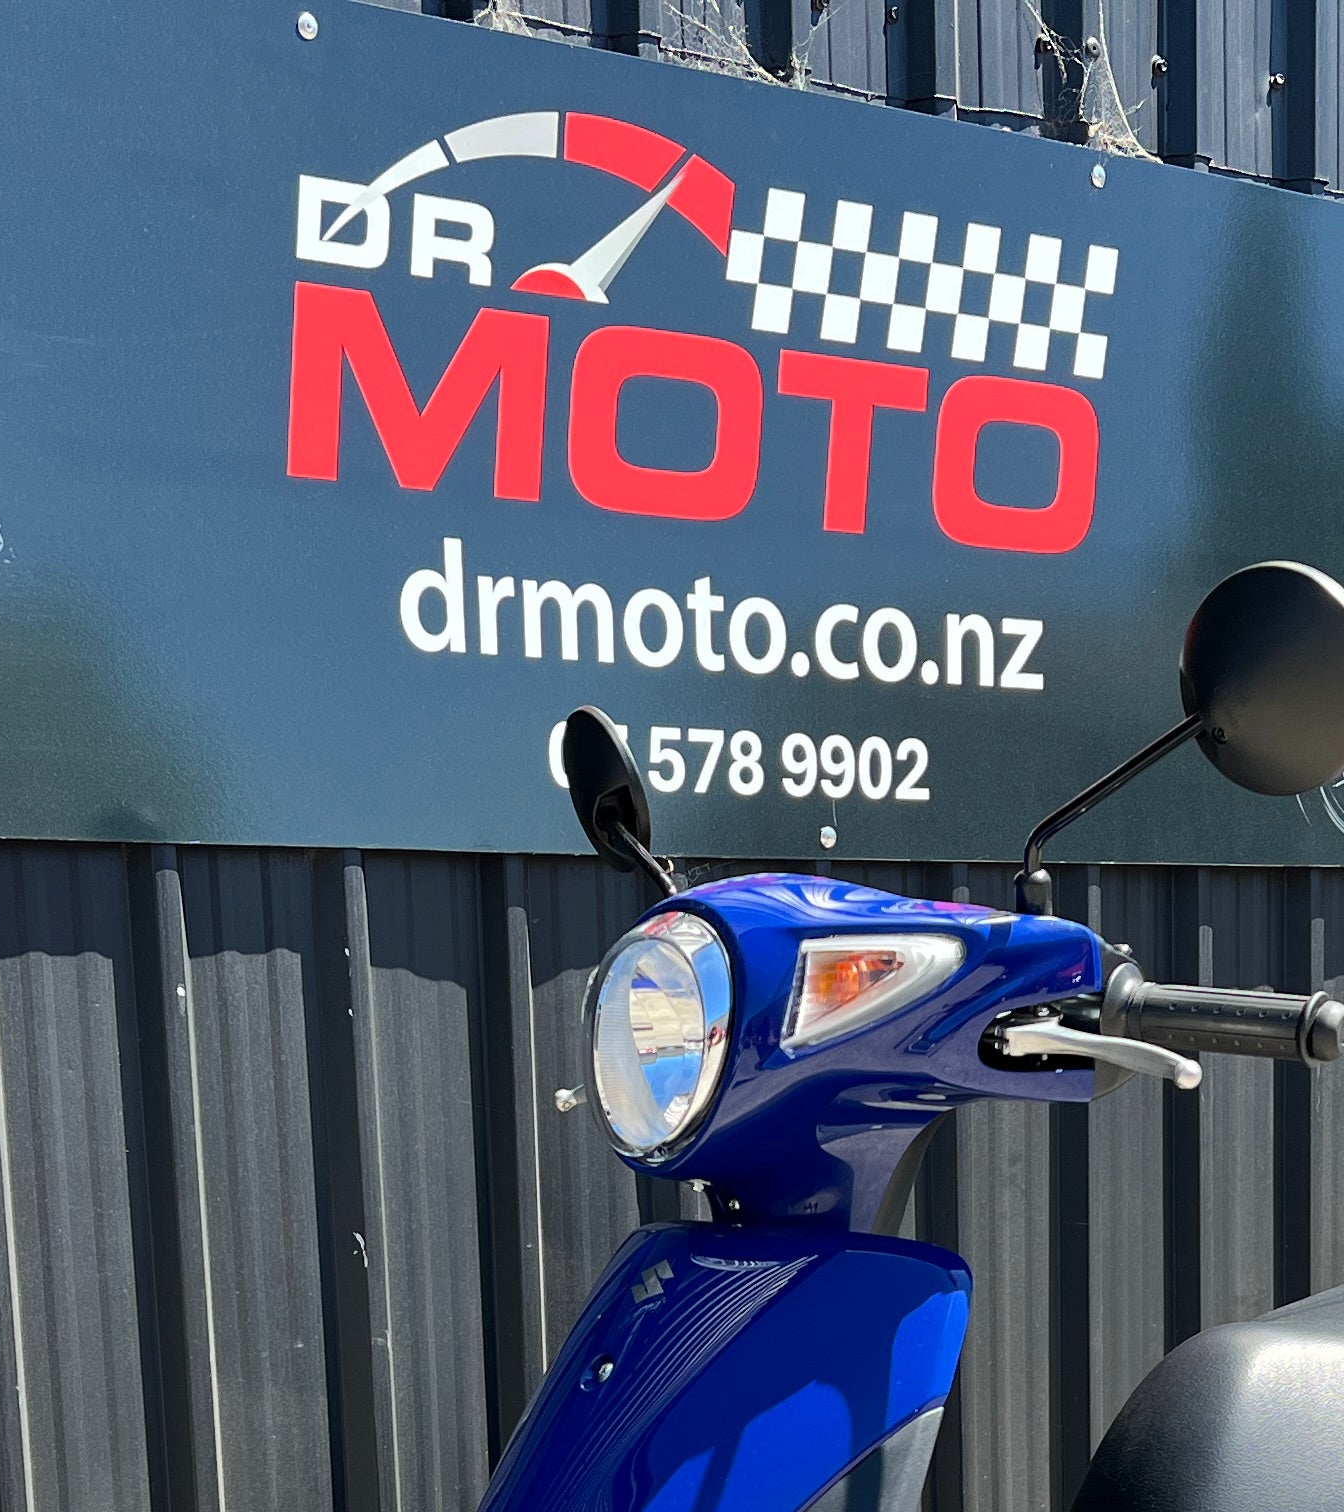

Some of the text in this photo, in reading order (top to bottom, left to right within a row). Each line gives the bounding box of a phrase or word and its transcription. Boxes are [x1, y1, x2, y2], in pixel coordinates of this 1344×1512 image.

[296, 173, 495, 287] DR
[288, 281, 1099, 554] MOTO
[399, 537, 1045, 690] drmoto.co.nz
[648, 726, 764, 796] 578
[781, 732, 931, 801] 9902
